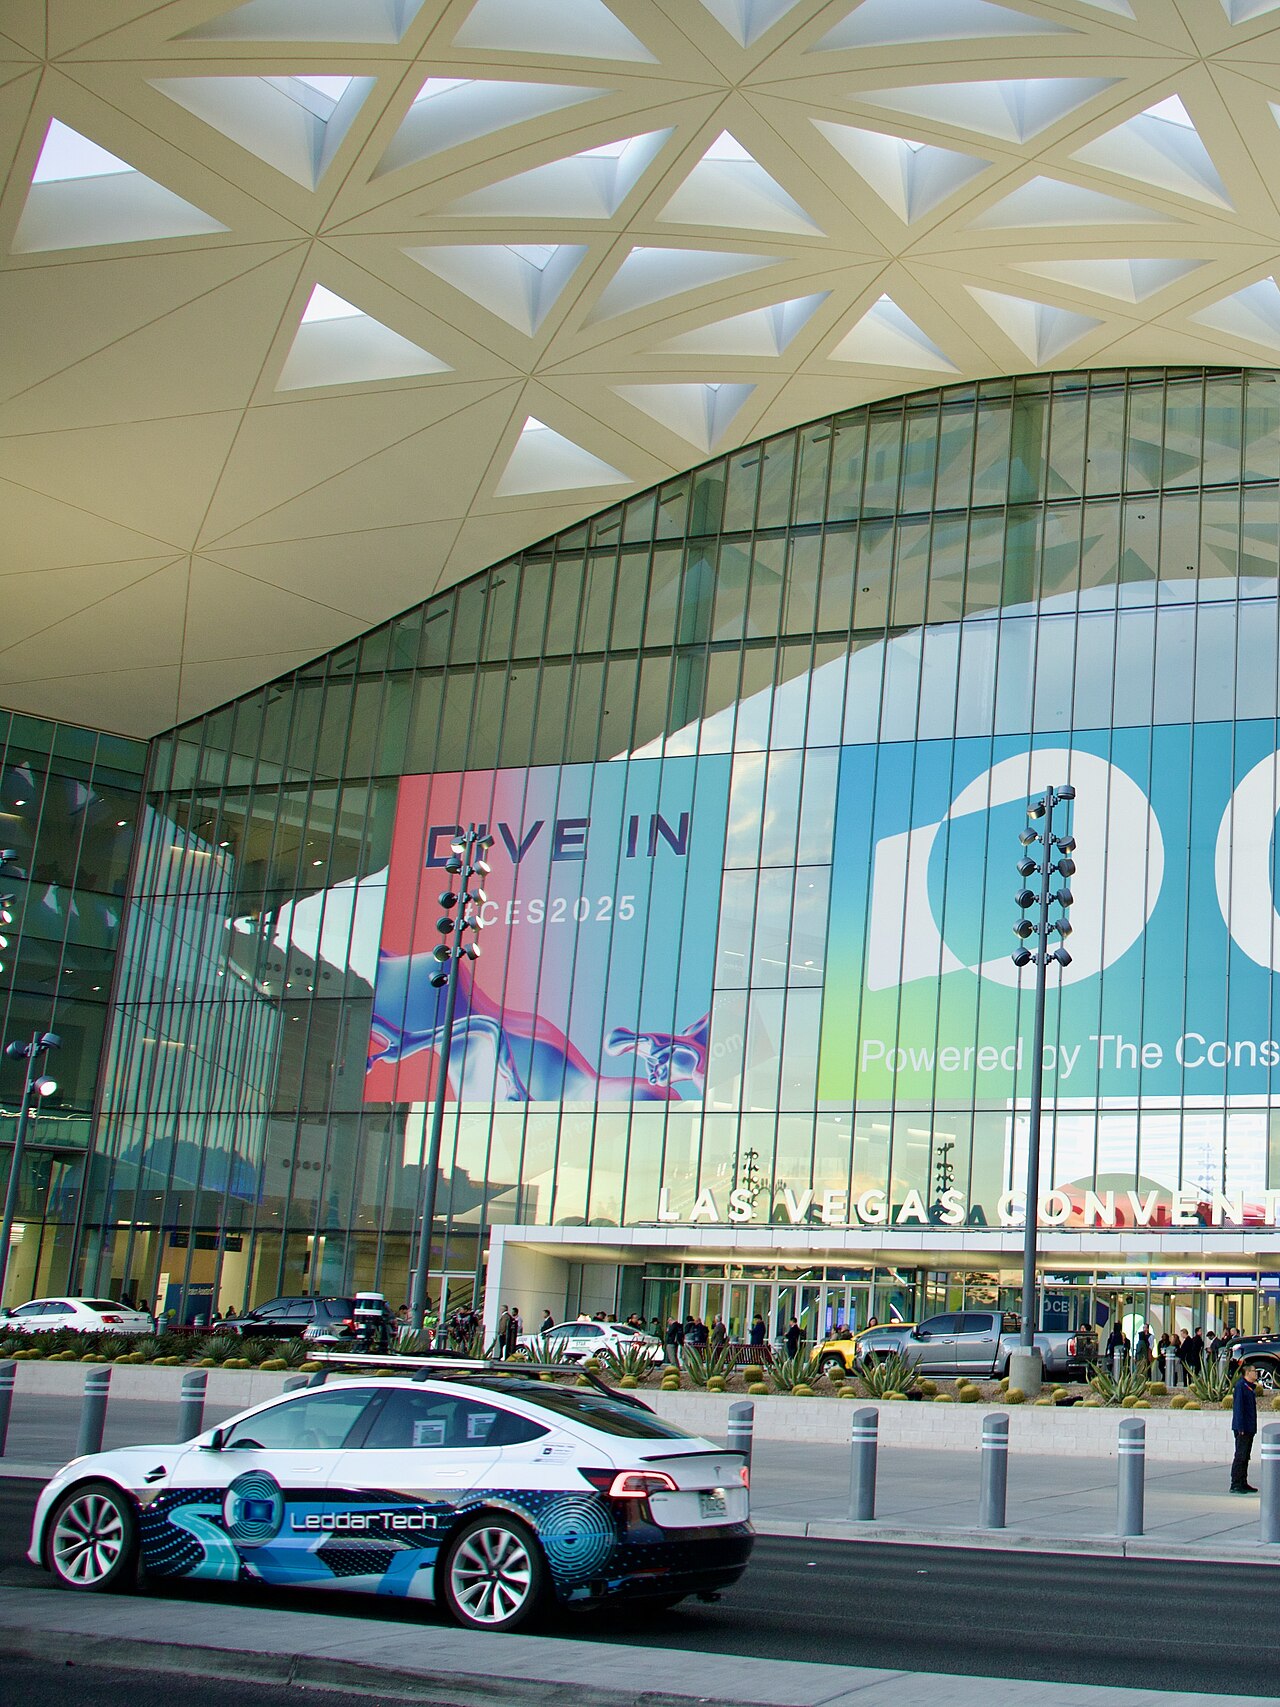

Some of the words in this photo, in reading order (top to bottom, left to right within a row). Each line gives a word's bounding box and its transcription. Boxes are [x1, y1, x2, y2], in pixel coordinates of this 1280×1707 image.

[425, 817, 591, 868] DIVE
[626, 812, 689, 858] IN
[861, 1036, 1024, 1073] Powered
[1089, 1034, 1163, 1070] The
[658, 1187, 754, 1223] LAS
[783, 1187, 967, 1225] VEGAS
[290, 1511, 438, 1530] LeddarTech
